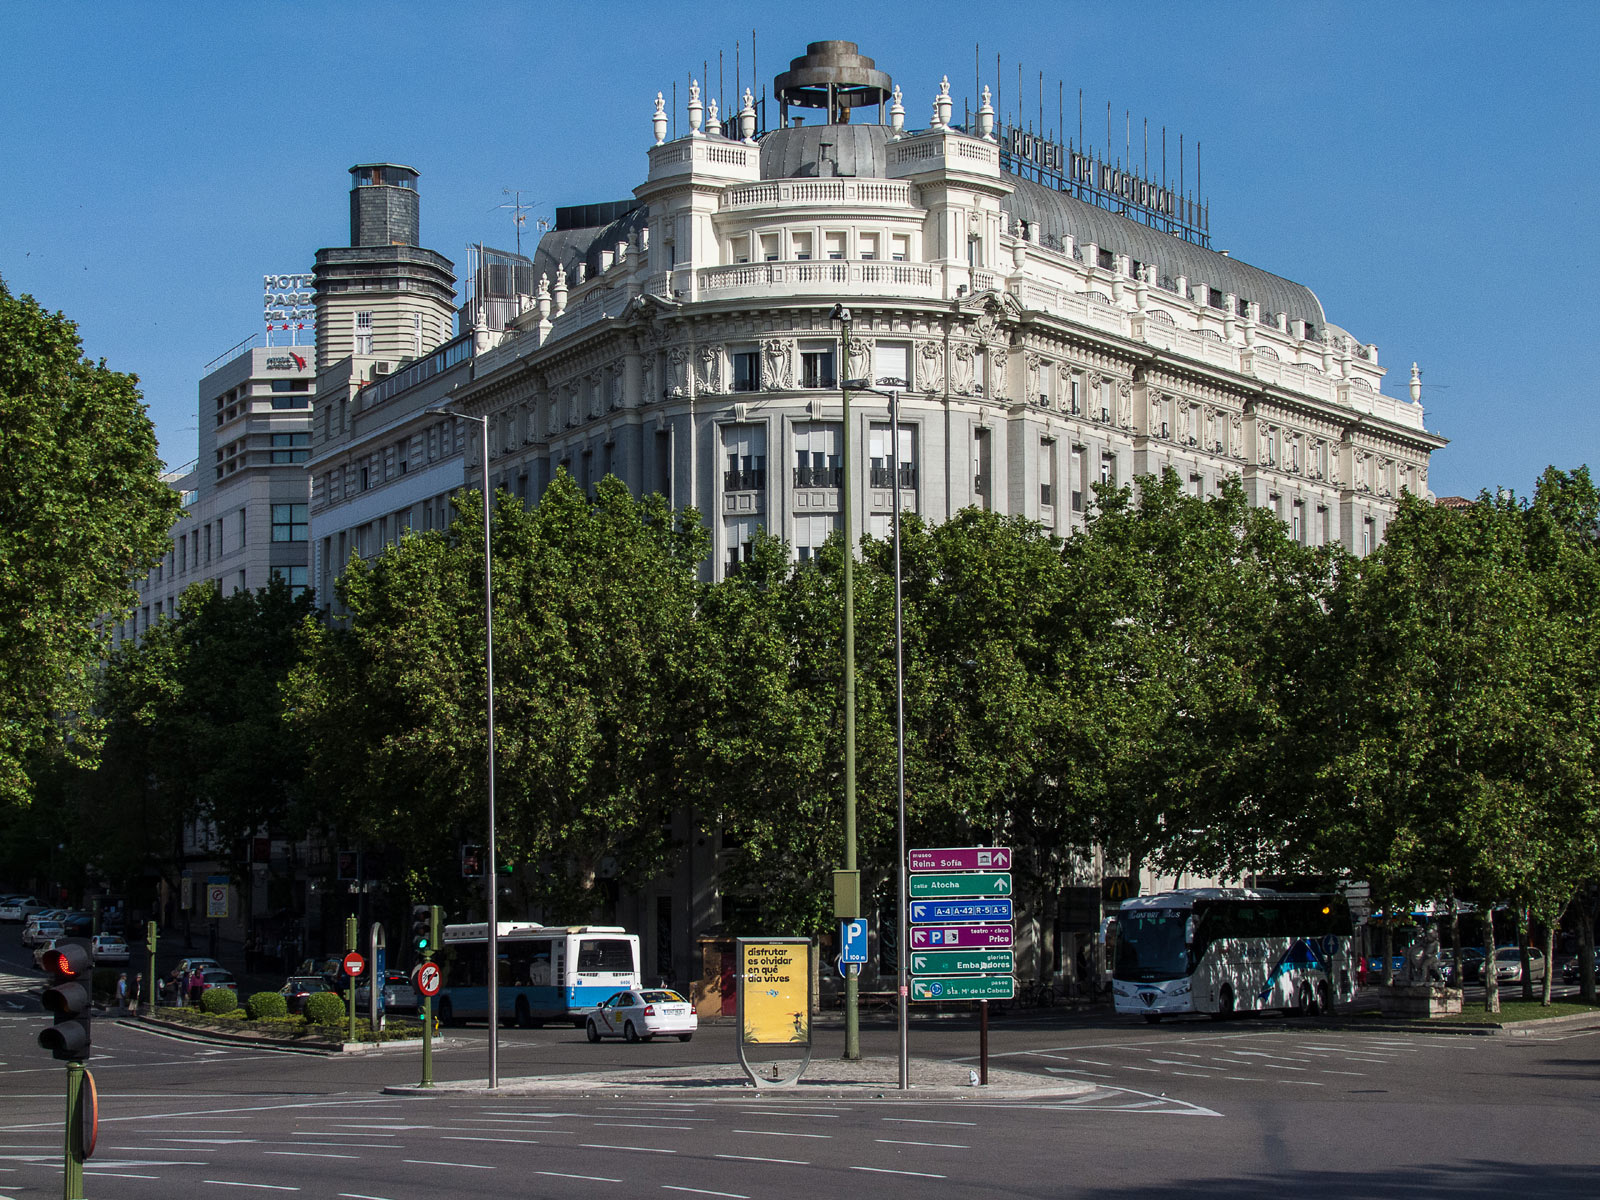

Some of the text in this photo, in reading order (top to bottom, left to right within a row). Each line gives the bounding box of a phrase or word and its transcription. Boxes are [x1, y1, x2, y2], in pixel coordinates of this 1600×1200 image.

[1013, 129, 1063, 172] HOTEL
[1102, 165, 1175, 216] NACIONAL
[263, 274, 316, 289] HOTE
[263, 292, 313, 307] PASE
[263, 310, 289, 320] DEL
[912, 860, 936, 868] Reina
[931, 881, 960, 889] Atocha
[954, 907, 973, 915] A-42
[848, 923, 862, 944] P
[989, 935, 1010, 943] Price
[748, 947, 788, 956] disfrutar
[760, 956, 793, 965] olvidar
[761, 964, 778, 975] qué
[957, 961, 1011, 970] Embajadores
[764, 973, 790, 982] vives
